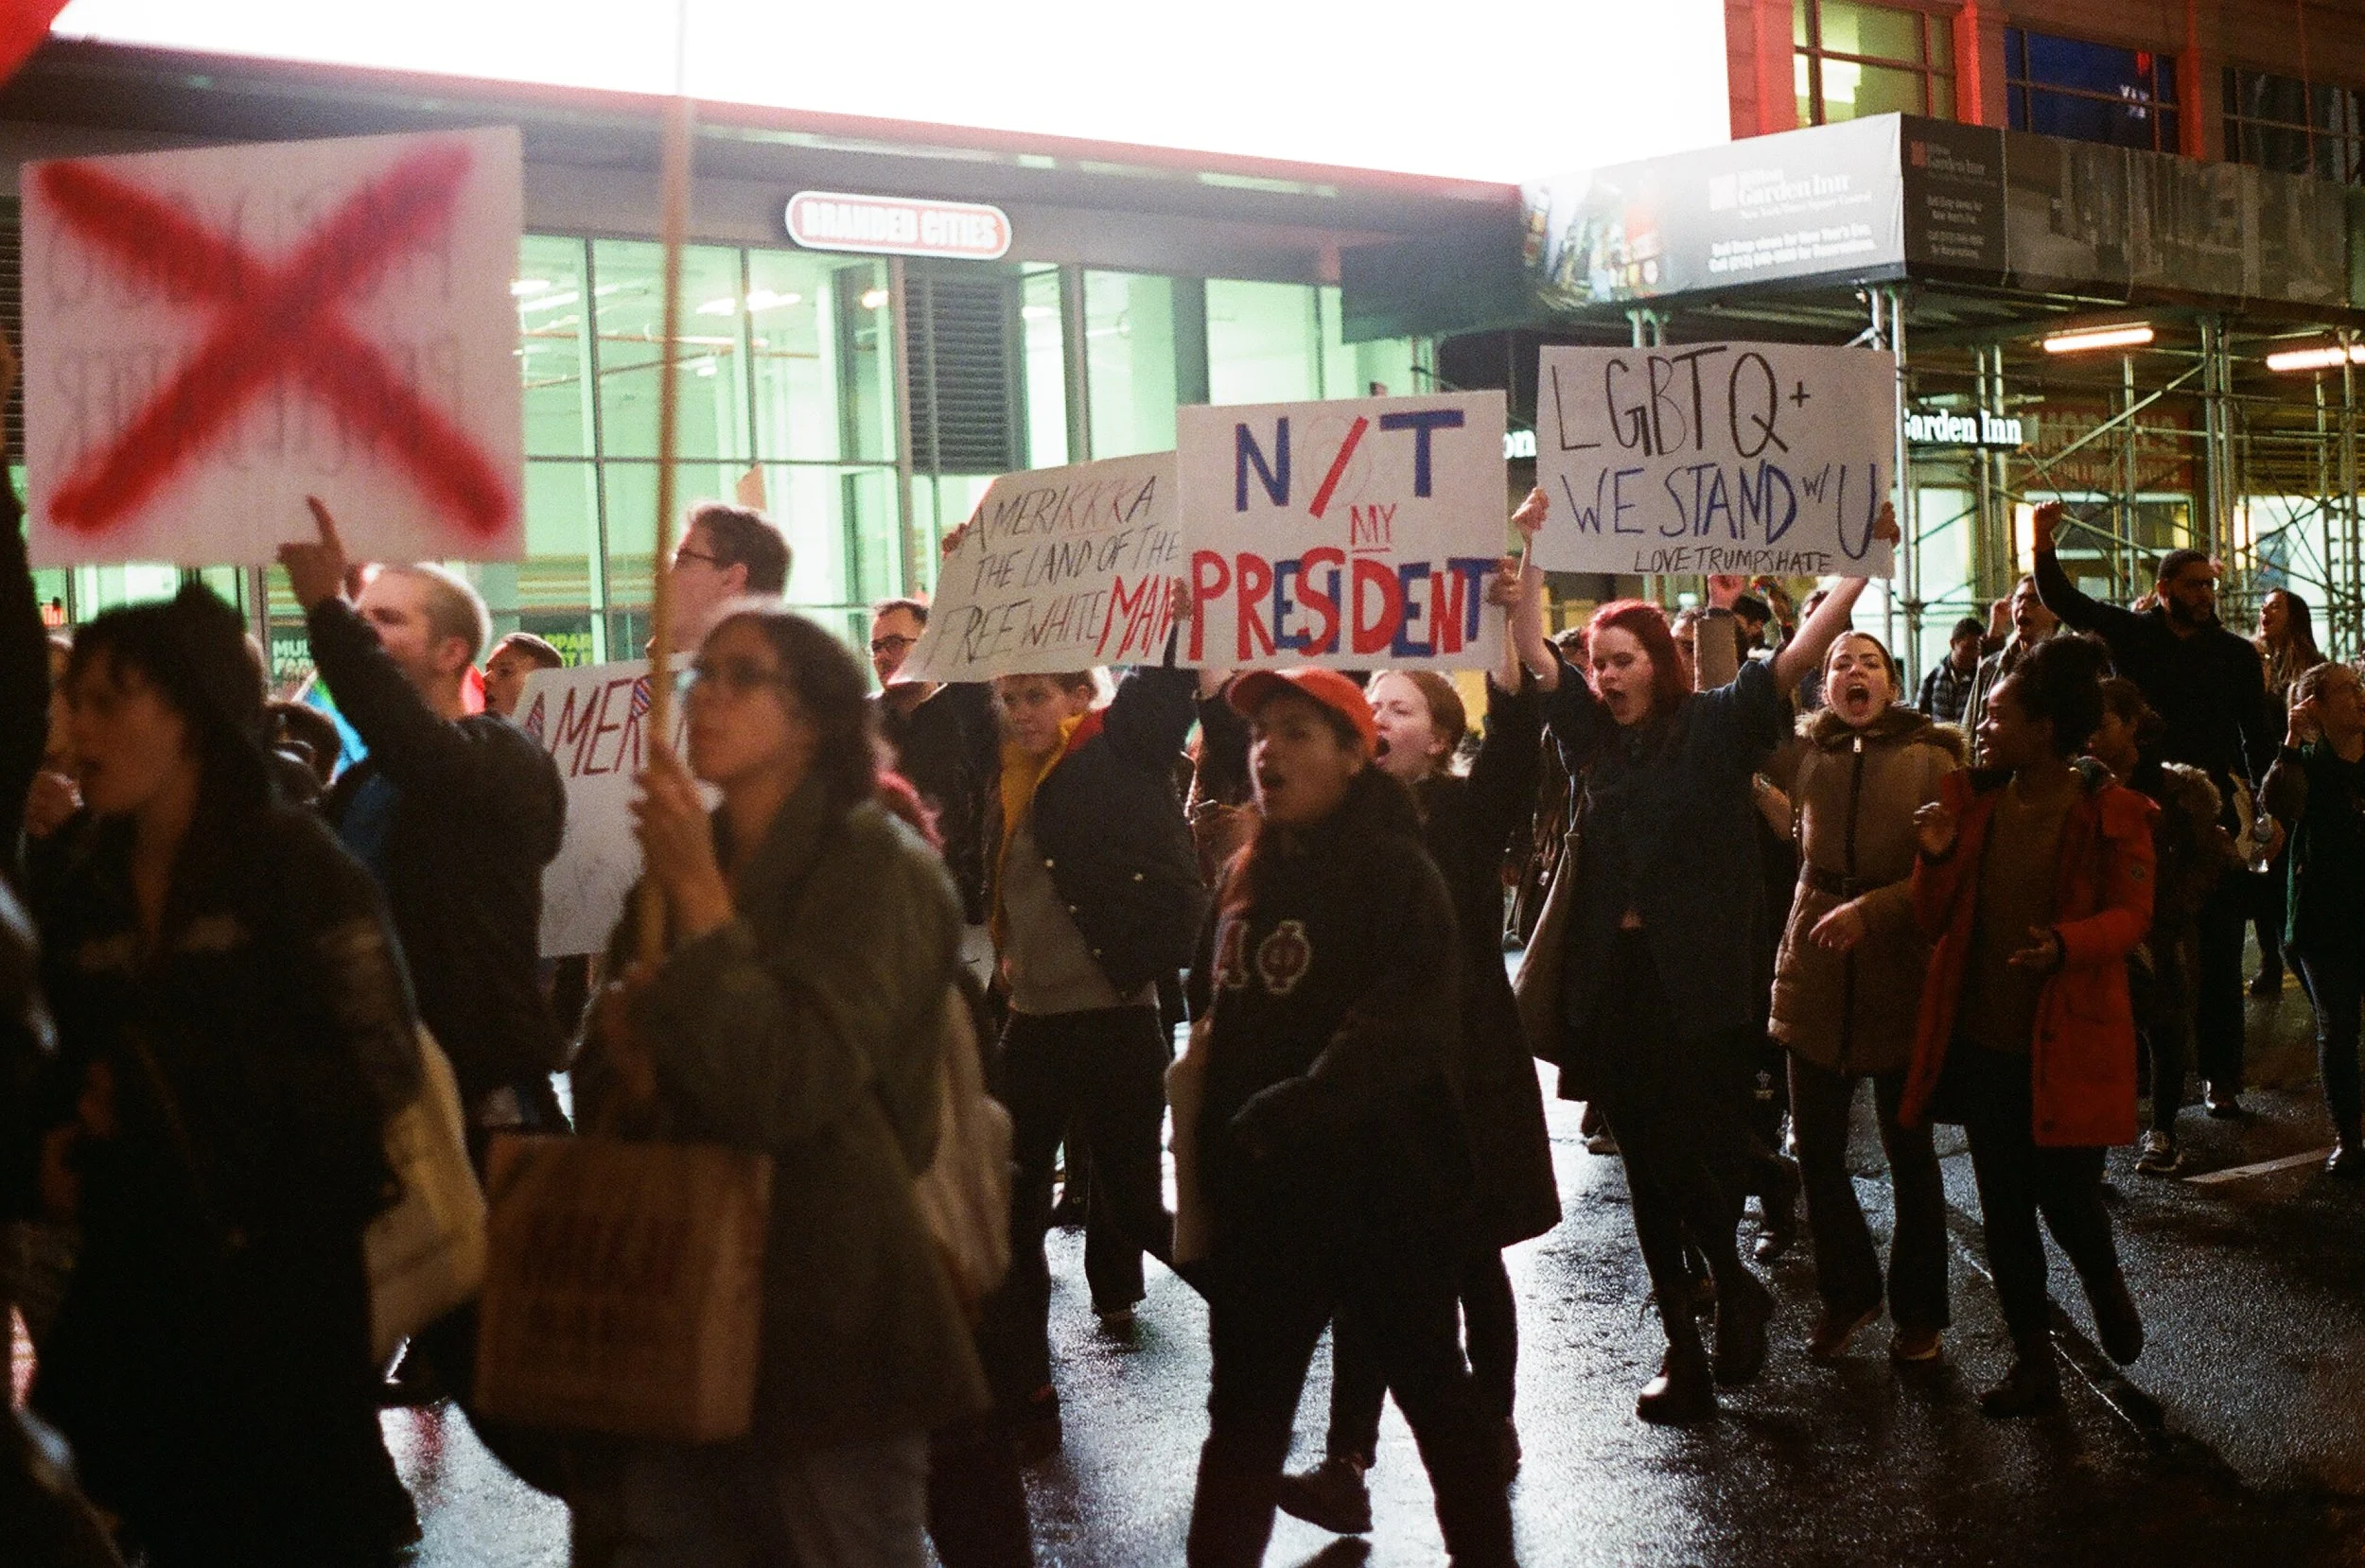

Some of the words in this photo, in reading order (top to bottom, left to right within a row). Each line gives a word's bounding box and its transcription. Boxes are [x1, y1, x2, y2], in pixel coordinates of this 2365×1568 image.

[800, 200, 919, 244] BRANDED
[920, 210, 999, 249] CITIES
[1980, 407, 2023, 444] Inn
[1349, 502, 1397, 546] MY
[1559, 467, 1645, 535] WE
[1658, 458, 1797, 546] STAND
[1836, 462, 1877, 561] U
[972, 549, 1024, 597] THE
[1021, 538, 1093, 588] LAND
[1096, 528, 1135, 573] OF
[1131, 521, 1181, 571] THE
[1633, 546, 1691, 573] LOVE
[1693, 545, 1775, 573] TRUMPS
[1776, 549, 1832, 575] HATE
[922, 597, 1032, 671] FREE
[1020, 589, 1108, 648] WHITE
[1094, 573, 1174, 661] MAN
[1187, 547, 1502, 663] PRESIDENT
